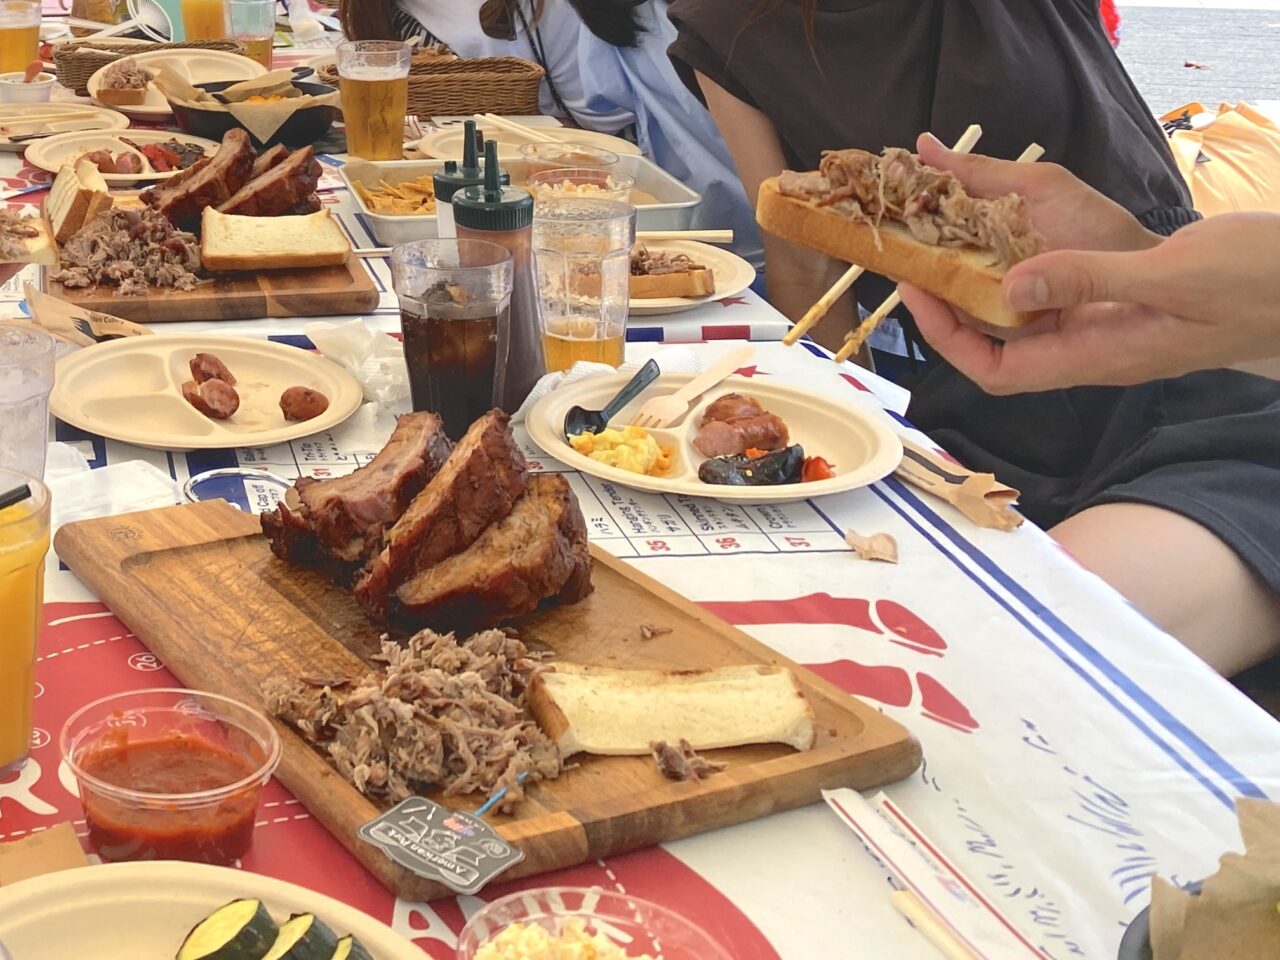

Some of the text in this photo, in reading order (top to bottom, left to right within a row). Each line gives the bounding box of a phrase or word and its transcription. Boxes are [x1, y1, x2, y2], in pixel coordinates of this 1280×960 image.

[601, 483, 647, 534] Hanging Tender
[591, 517, 614, 535] ハラミ
[646, 540, 671, 552] 35
[716, 537, 741, 549] 36
[784, 536, 811, 547] 37
[410, 843, 468, 874] American
